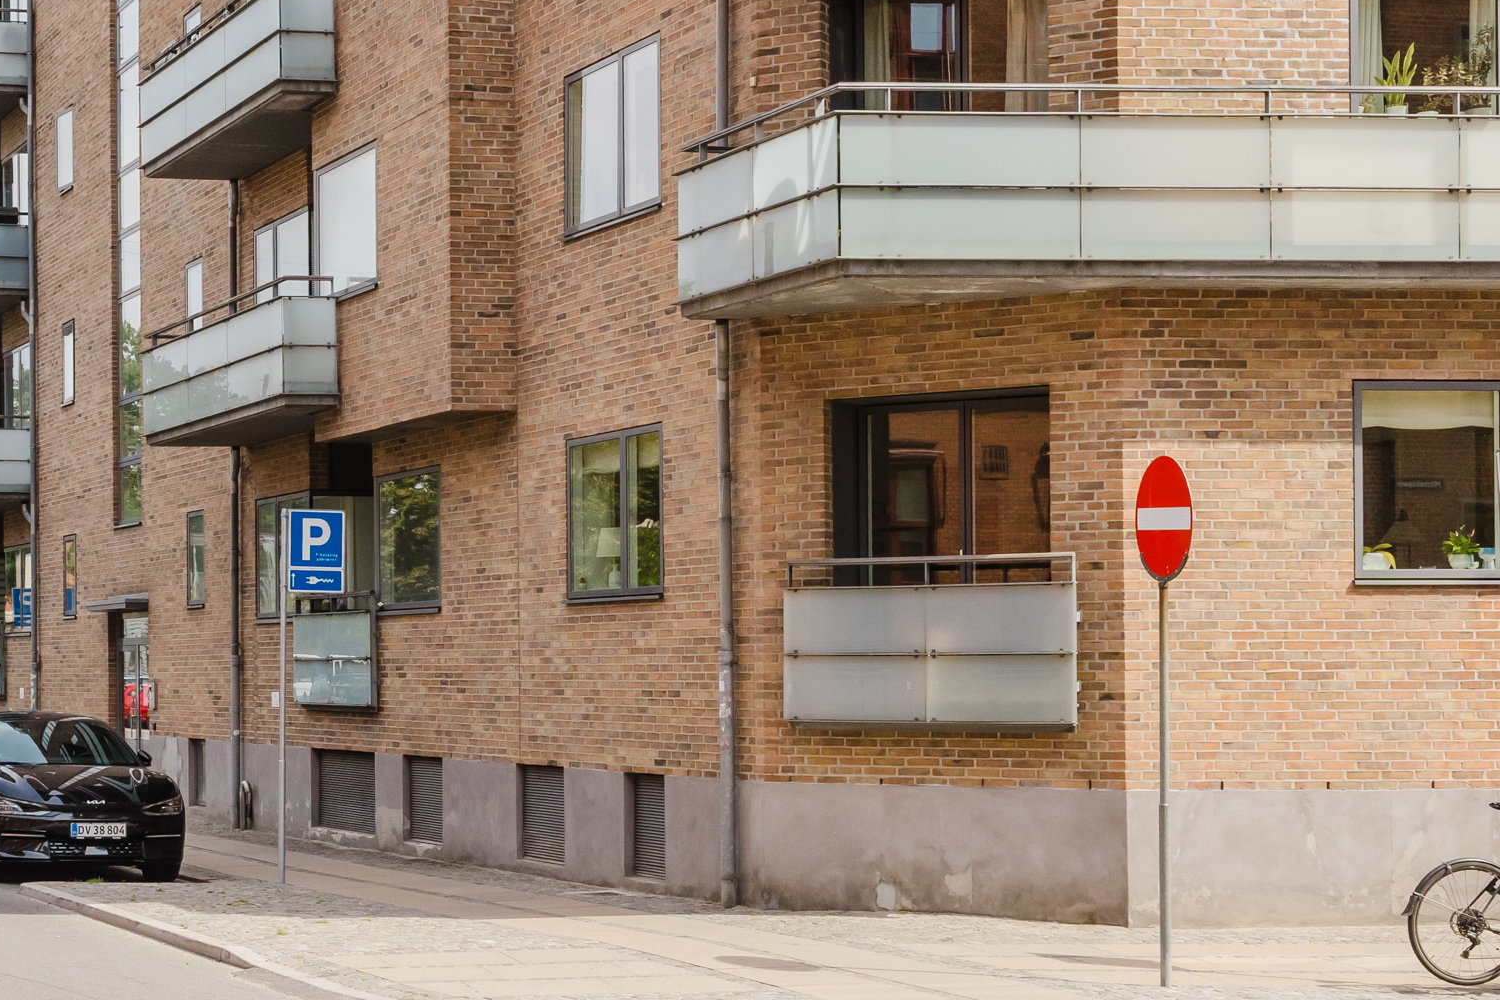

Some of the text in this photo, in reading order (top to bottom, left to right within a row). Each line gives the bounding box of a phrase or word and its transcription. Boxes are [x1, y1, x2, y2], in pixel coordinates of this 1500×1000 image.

[302, 518, 331, 560] P
[78, 825, 125, 835] DV 38 804
